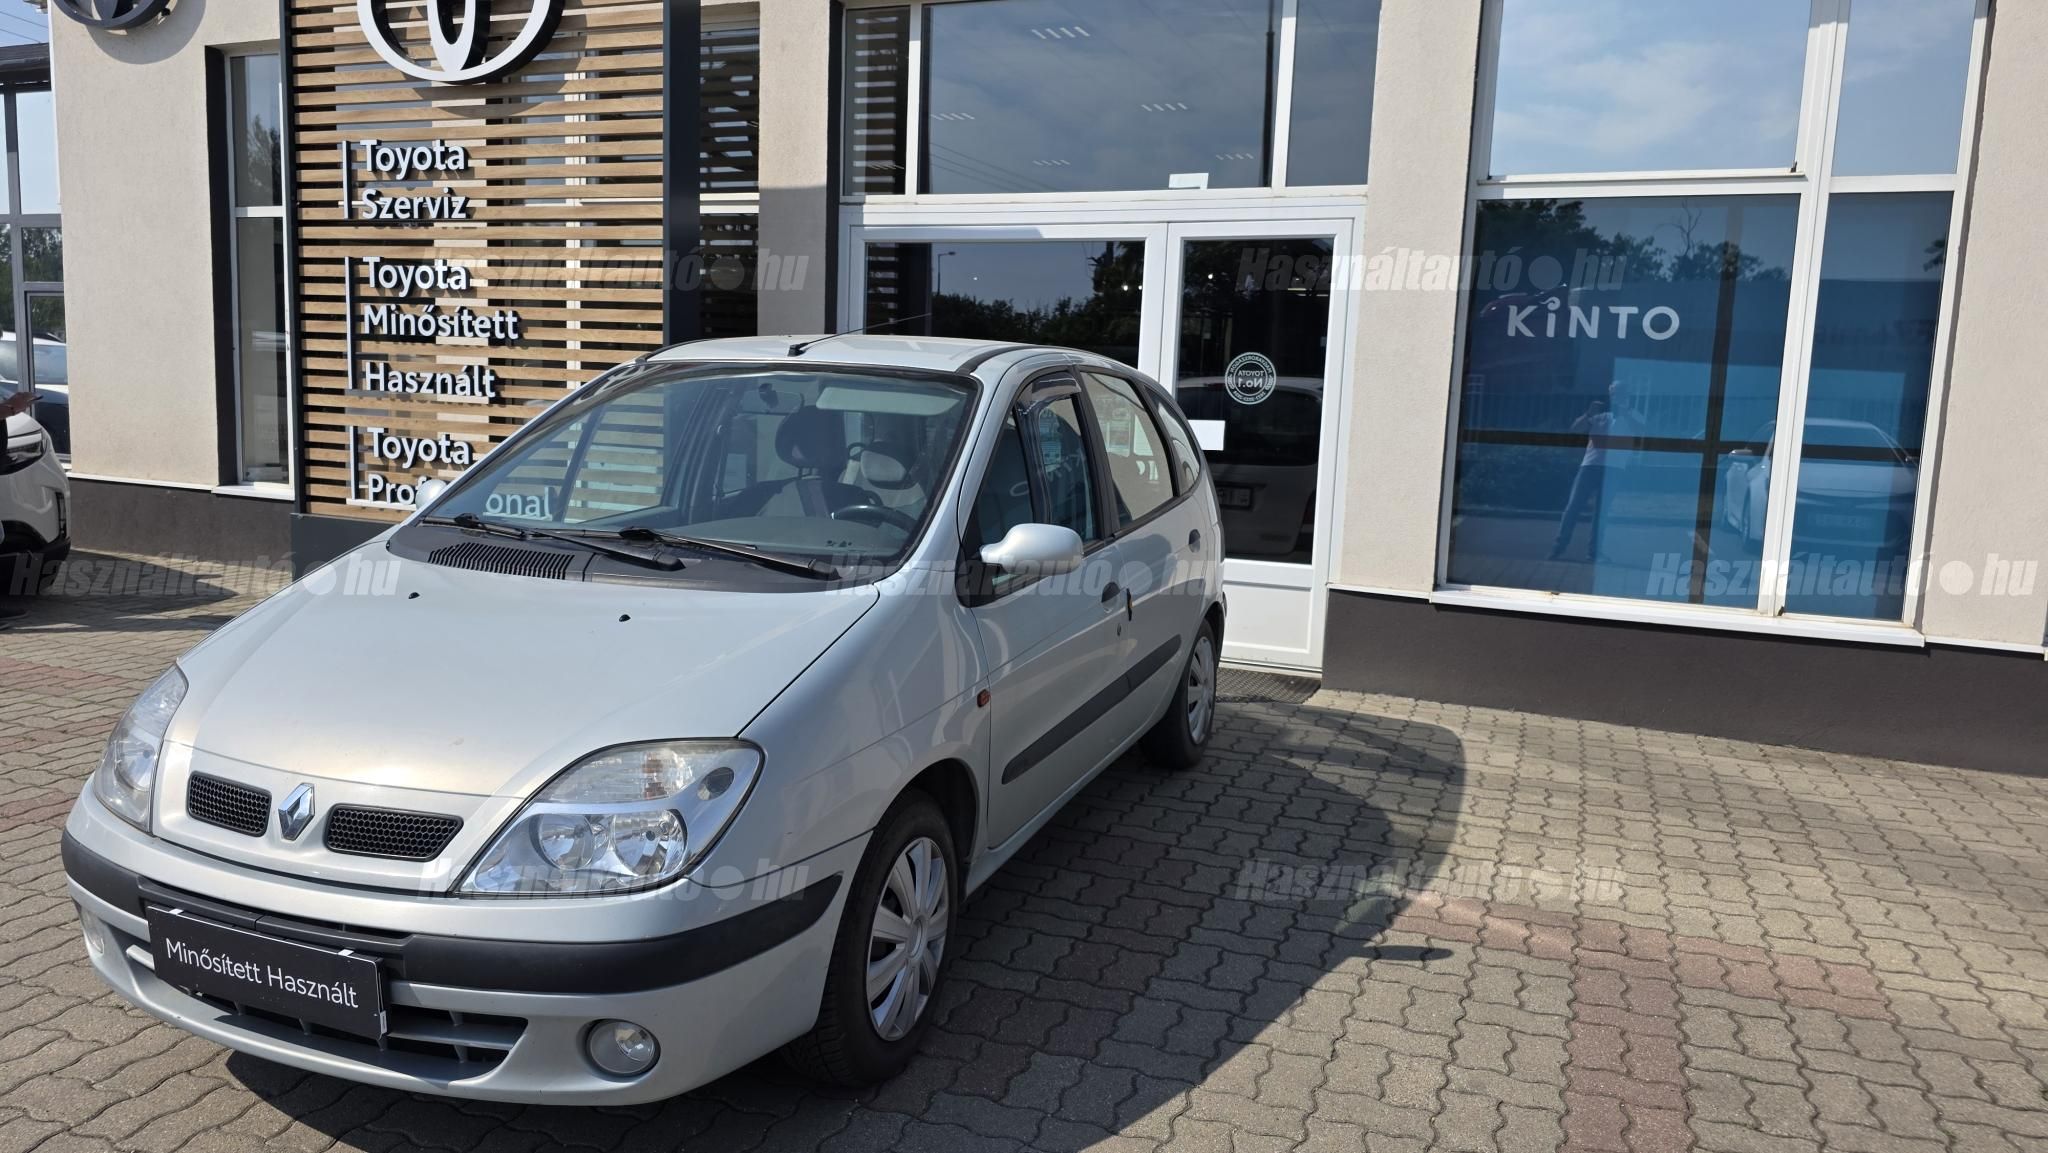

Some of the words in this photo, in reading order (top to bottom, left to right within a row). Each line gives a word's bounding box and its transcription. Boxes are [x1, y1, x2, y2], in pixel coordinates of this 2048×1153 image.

[360, 139, 466, 180] Toyota
[362, 187, 468, 219] Szerviz
[363, 256, 467, 297] Toyota
[363, 304, 519, 339] Minősített
[365, 361, 496, 398] Használt
[368, 427, 472, 469] Toyota
[165, 937, 262, 984] Minősített
[267, 965, 359, 1008] Használt
